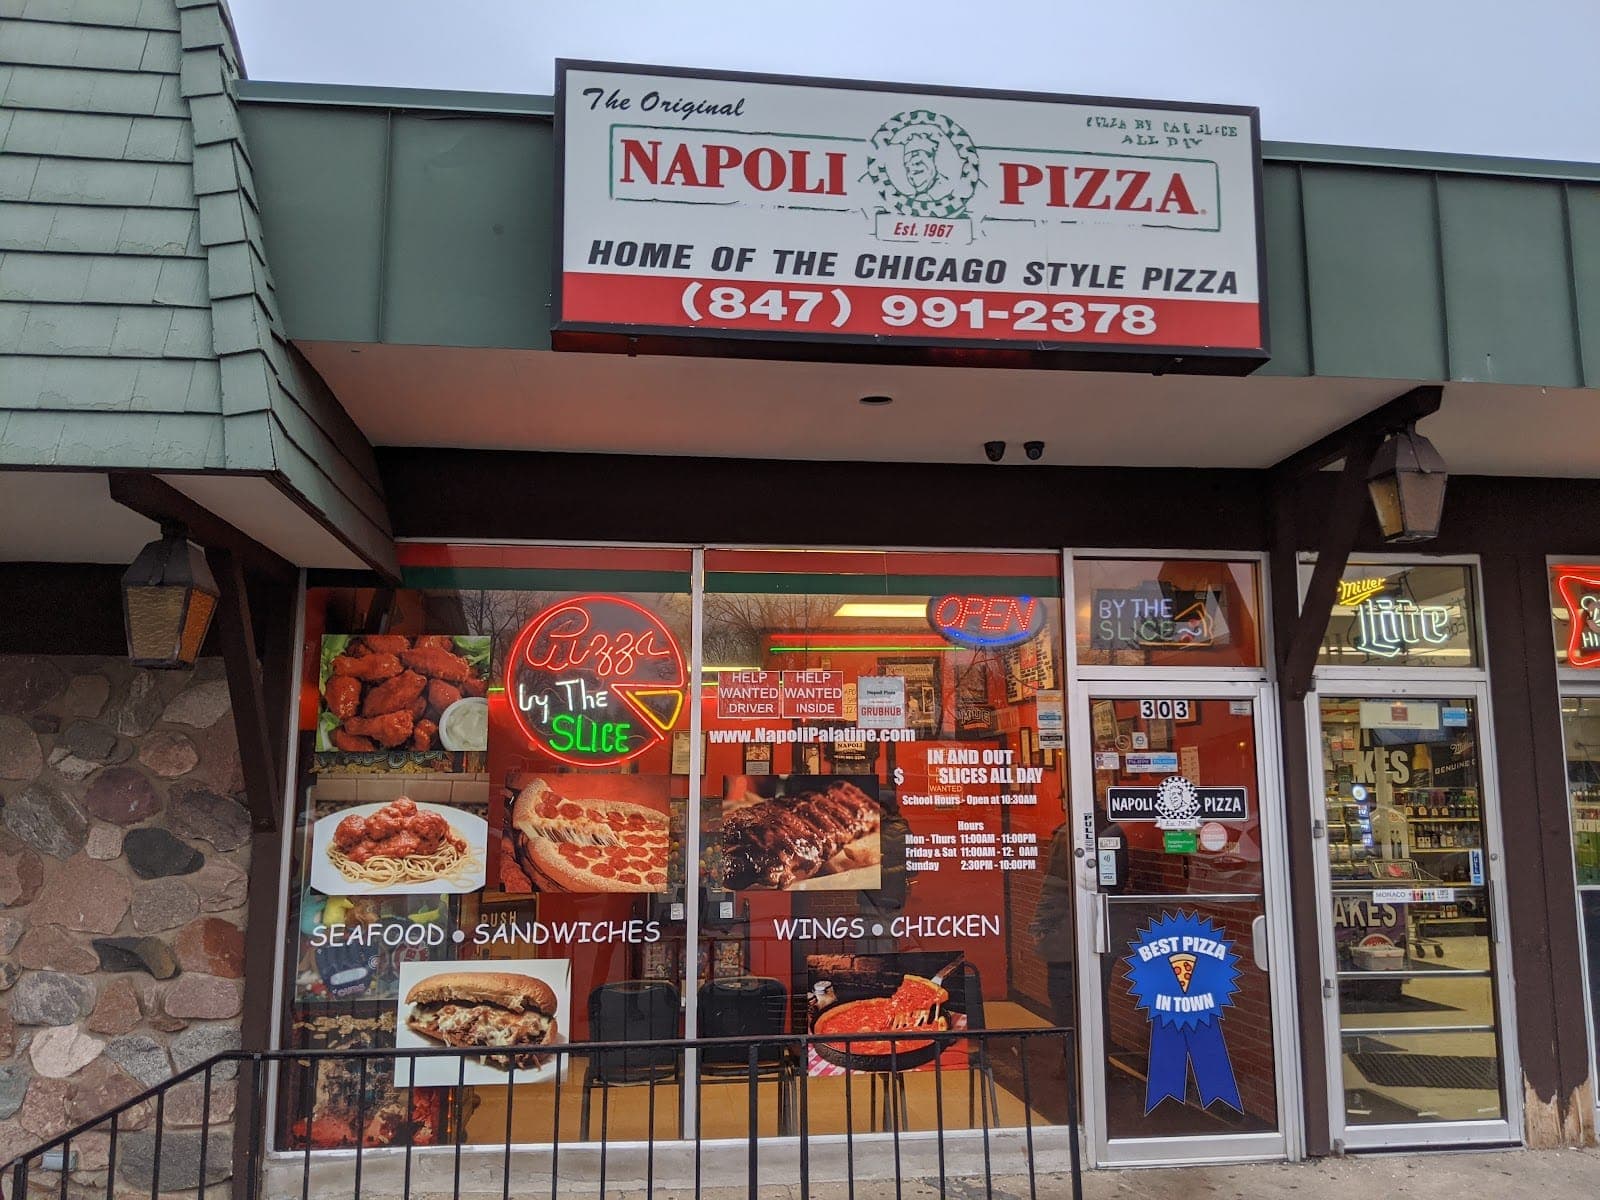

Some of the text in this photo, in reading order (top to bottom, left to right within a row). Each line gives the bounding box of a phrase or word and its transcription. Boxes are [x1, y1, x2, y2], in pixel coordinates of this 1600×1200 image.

[581, 87, 745, 120] The Original
[619, 138, 1199, 215] NAPOLI PIZZA
[893, 222, 954, 238] Est. 1967
[587, 239, 1238, 295] HOME OF THE CHICAGO STYLE PIZZA
[681, 281, 1157, 336] (847) 991-2378
[1338, 578, 1386, 600] Miller
[936, 595, 1036, 631] OPEN
[1099, 598, 1174, 619] BY THE
[1100, 620, 1175, 641] SLICE
[1357, 598, 1448, 657] Lite
[525, 606, 670, 676] Pizza
[732, 671, 767, 683] HELP
[796, 671, 831, 683] HELP
[720, 688, 779, 699] WANTED
[784, 687, 842, 699] WANTED
[729, 704, 774, 713] DRIVER
[796, 704, 835, 713] INSIDE
[861, 706, 902, 716] GRUBHUB
[1142, 701, 1187, 718] 303
[549, 714, 631, 753] SLICE
[709, 726, 916, 745] www.NapoliPalatine.com
[927, 748, 1014, 765] IN AND OUT
[894, 767, 904, 786] $
[939, 767, 1043, 784] SLICES ALL DAY
[929, 784, 963, 793] WANTED
[902, 794, 932, 805] School
[935, 794, 960, 805] Hours
[967, 794, 989, 806] Open
[991, 795, 999, 804] at
[1001, 794, 1037, 805] 10:30AM
[1112, 797, 1242, 812] NAPOLI PIZZA
[957, 820, 985, 831] Hours
[905, 834, 925, 844] Mon
[931, 834, 957, 844] Thurs
[960, 833, 996, 844] 11:00AM
[1001, 833, 1037, 844] 11:00PM
[905, 847, 933, 858] Friday
[934, 848, 941, 857] &
[942, 847, 957, 857] Sat
[960, 846, 996, 857] 11:00AM
[906, 860, 939, 871] Sunday
[961, 860, 993, 870] 2:30PM
[999, 859, 1036, 870] 10:00PM
[481, 911, 517, 927] PUSH
[773, 914, 1000, 941] WINGS CHICKEN
[310, 920, 661, 947] SEAFOOD SANDWICHES
[1138, 936, 1226, 962] BEST PIZZA
[1155, 992, 1214, 1013] IN TOWN
